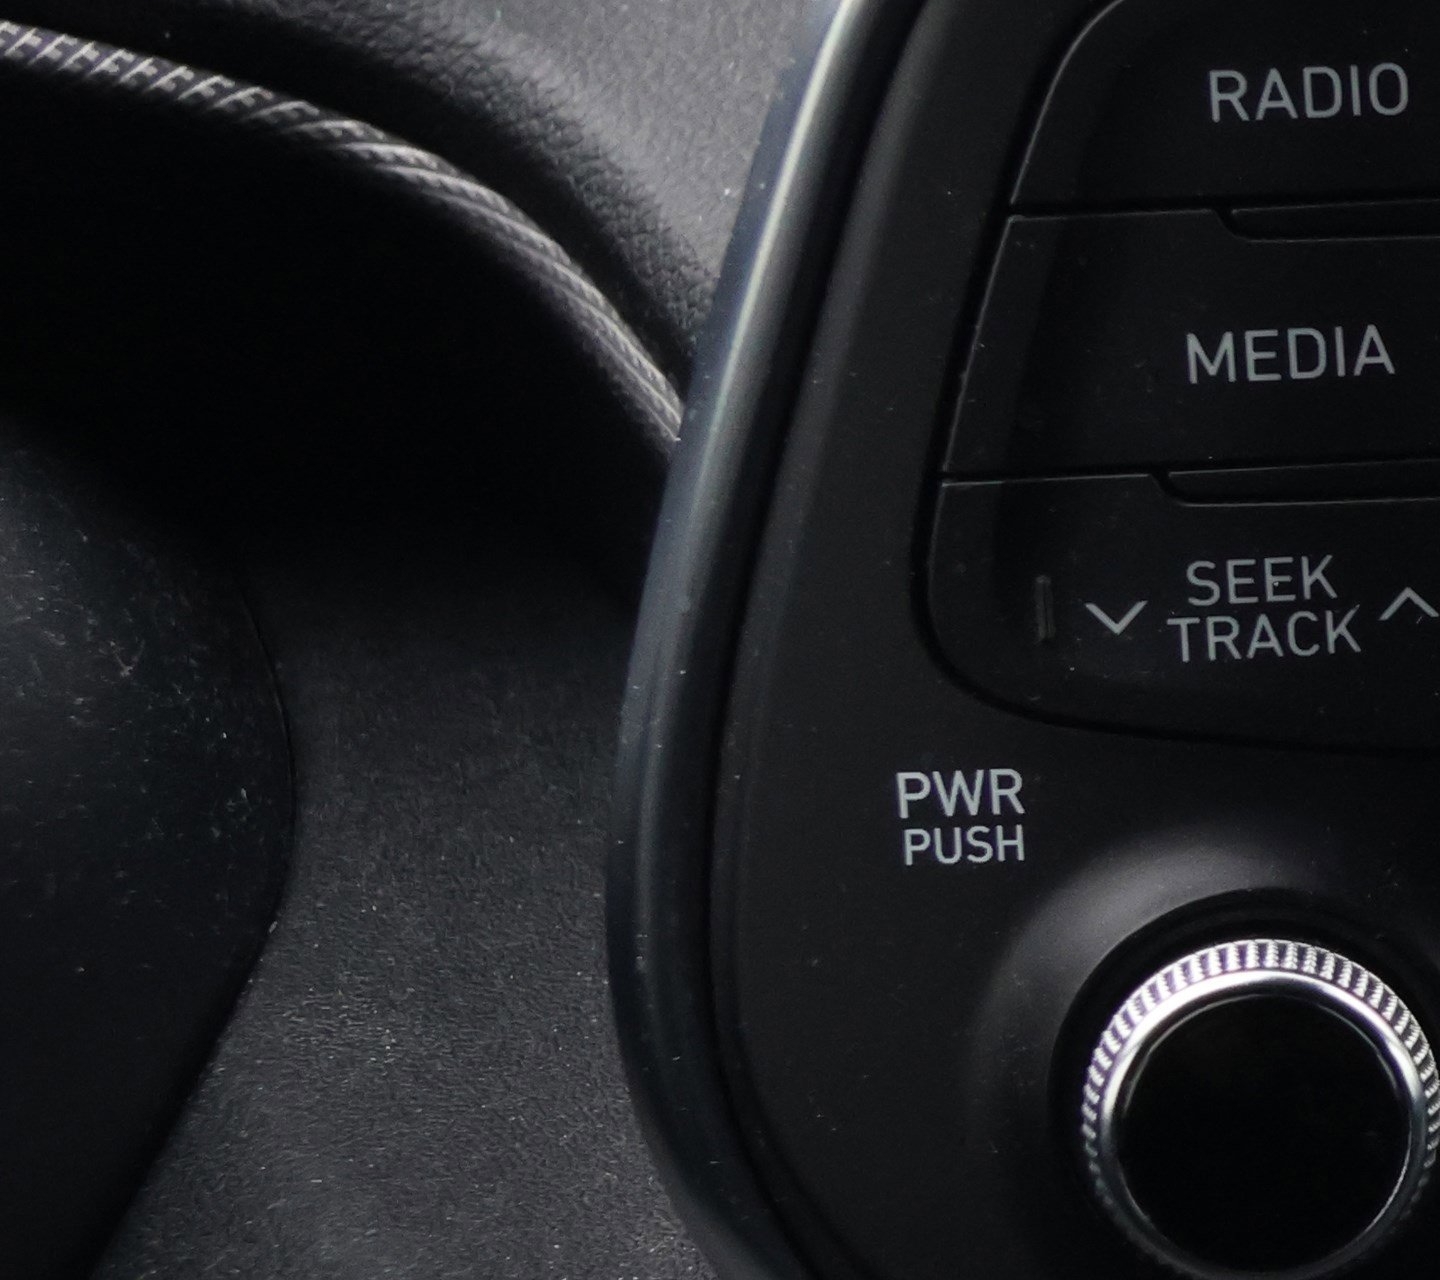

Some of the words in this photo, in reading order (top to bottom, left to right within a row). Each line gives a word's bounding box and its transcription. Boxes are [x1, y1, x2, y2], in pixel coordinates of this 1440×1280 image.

[1208, 62, 1410, 123] RADIO
[1185, 324, 1396, 385] MEDIA
[1185, 554, 1338, 608] SEEK
[1166, 608, 1362, 662] TRACK
[896, 768, 1026, 819] PWR
[903, 823, 1026, 866] PUSH
